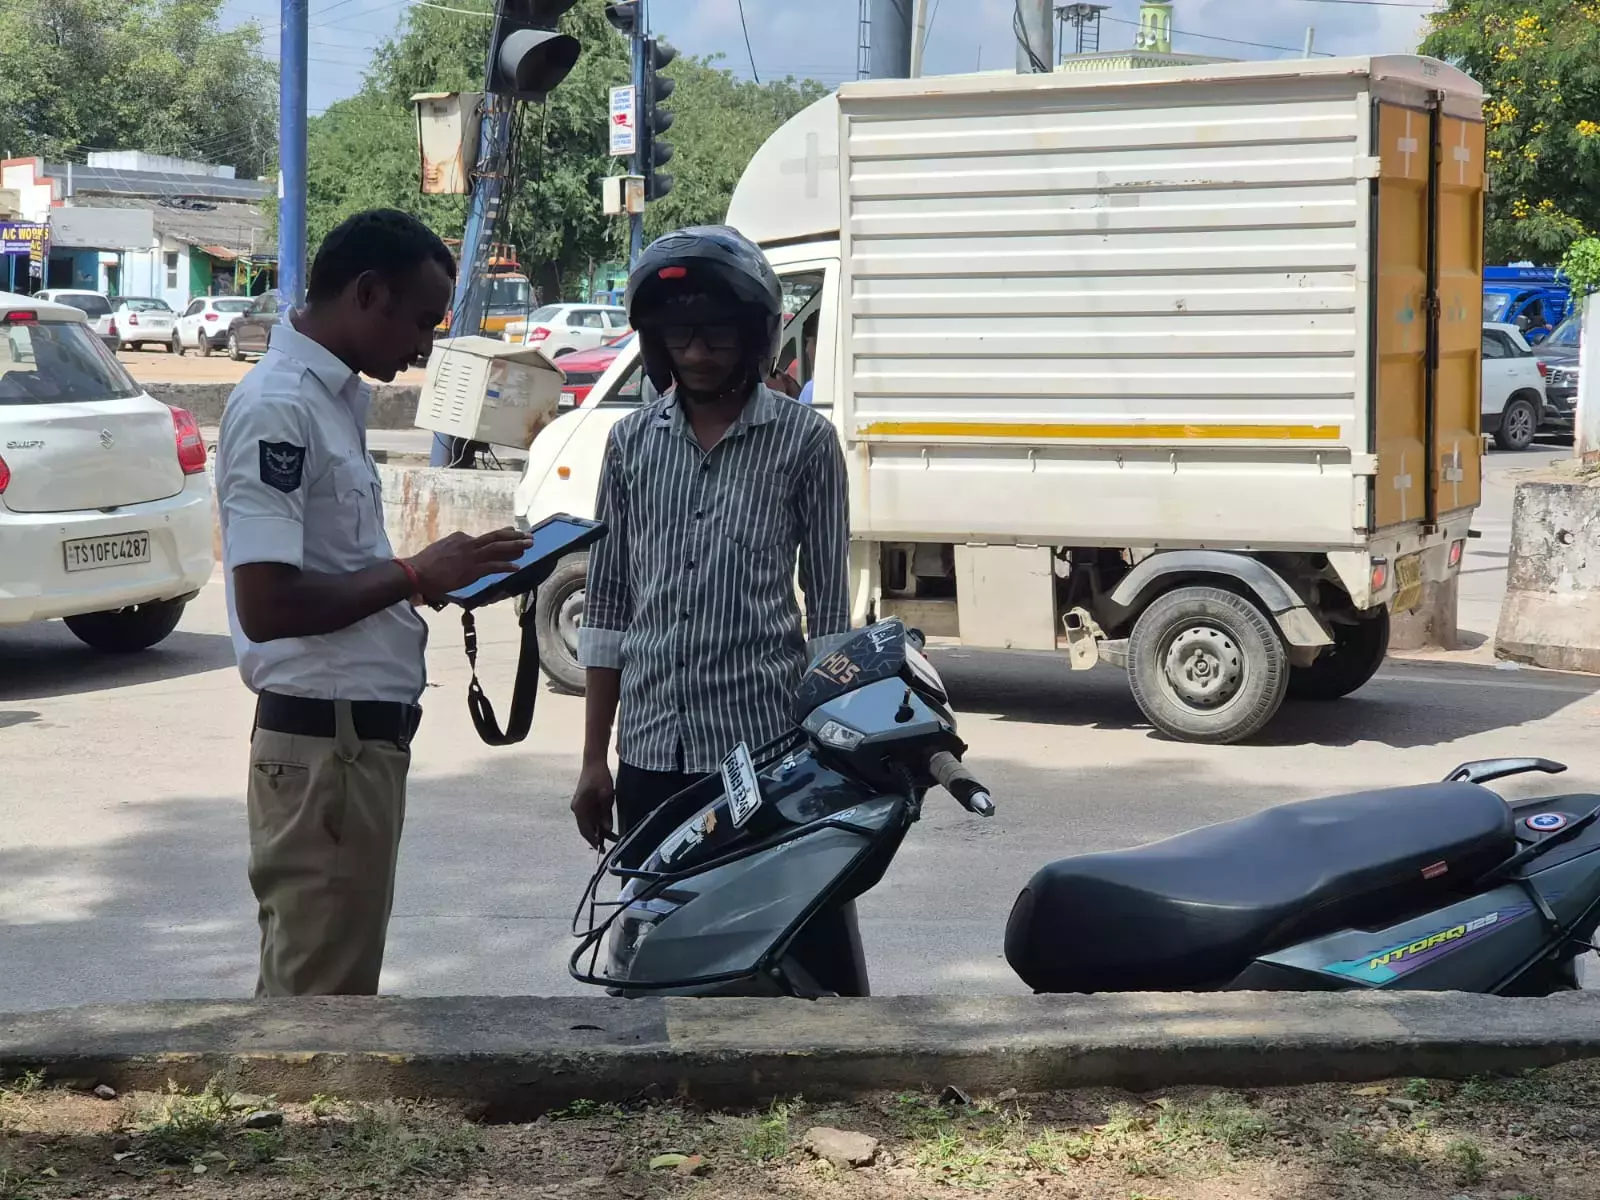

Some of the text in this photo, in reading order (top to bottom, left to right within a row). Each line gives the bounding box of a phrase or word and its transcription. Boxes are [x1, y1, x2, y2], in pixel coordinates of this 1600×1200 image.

[6, 440, 47, 450] SWIFT
[73, 537, 148, 565] TS10FC4287
[1369, 924, 1467, 970] NTORQ
